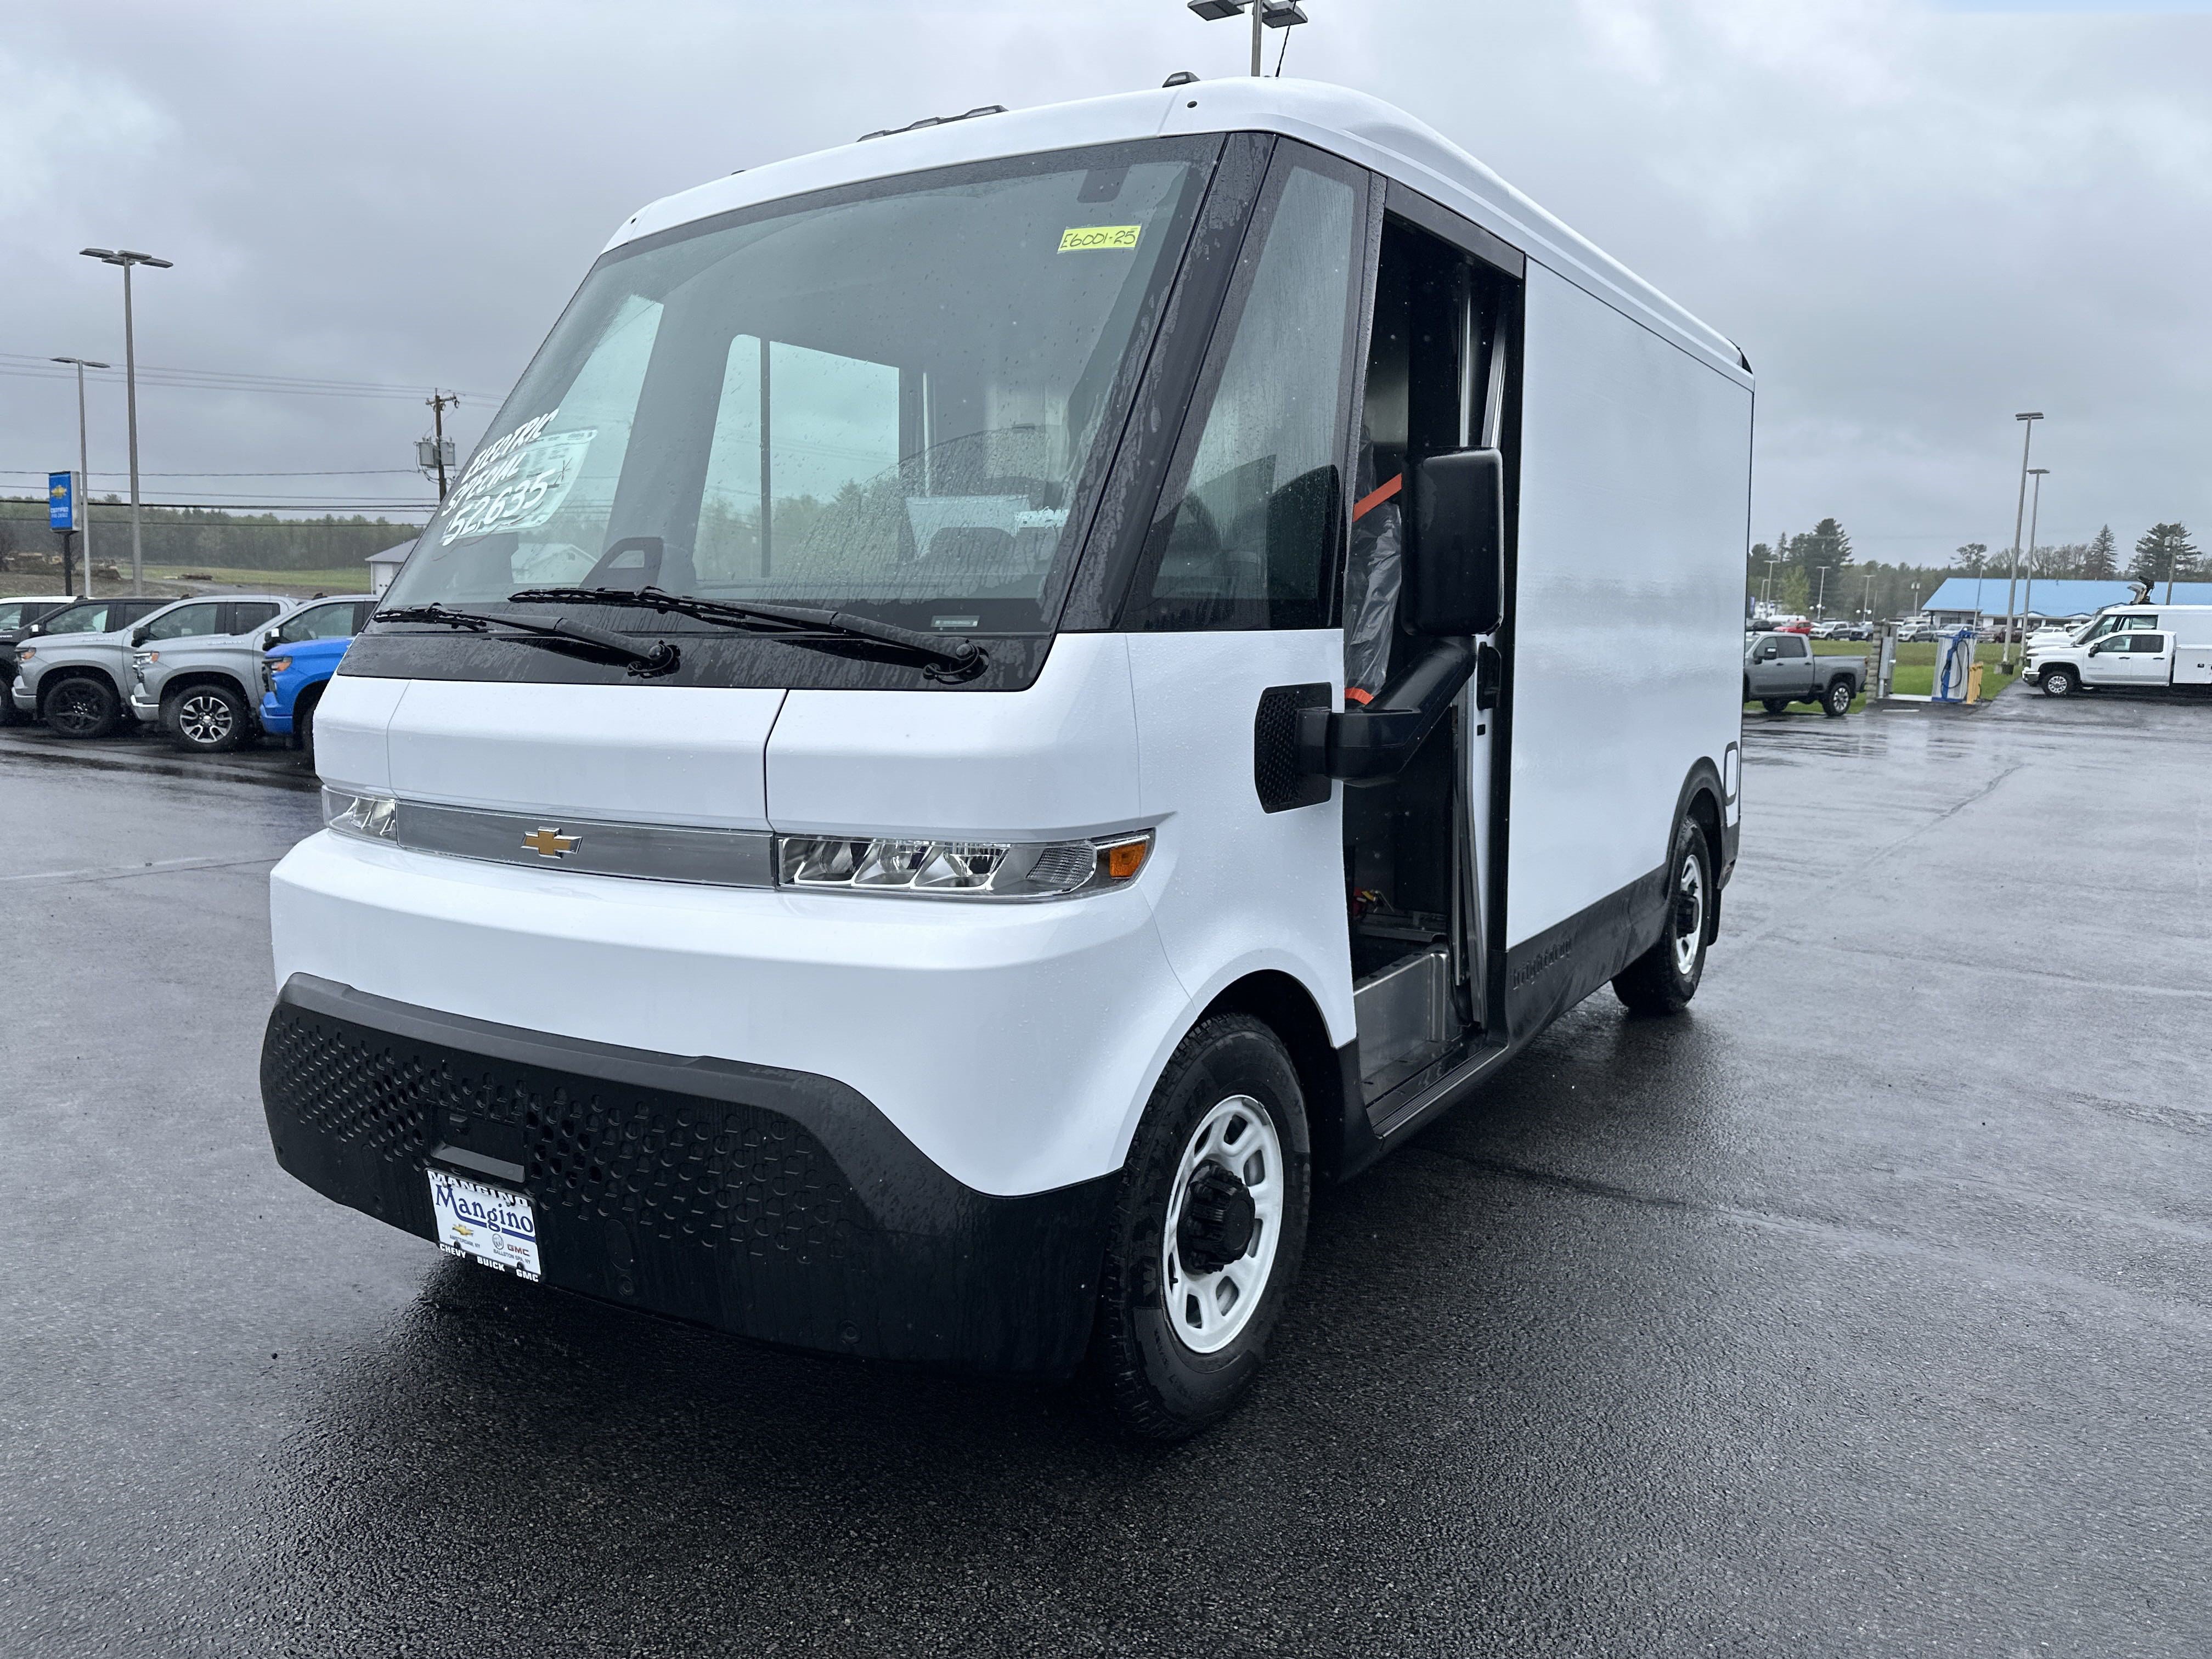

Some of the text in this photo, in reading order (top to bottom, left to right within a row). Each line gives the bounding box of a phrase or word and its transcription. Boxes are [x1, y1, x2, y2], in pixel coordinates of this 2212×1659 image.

[1060, 230, 1136, 249] E6001-25
[461, 408, 559, 484] ELECTRIC
[441, 452, 527, 517] SPECIAL
[427, 1170, 528, 1207] MANGINO
[436, 1184, 533, 1233] Mangino
[439, 1244, 539, 1282] CHEVY BUICK GMC
[507, 1244, 531, 1257] GMC
